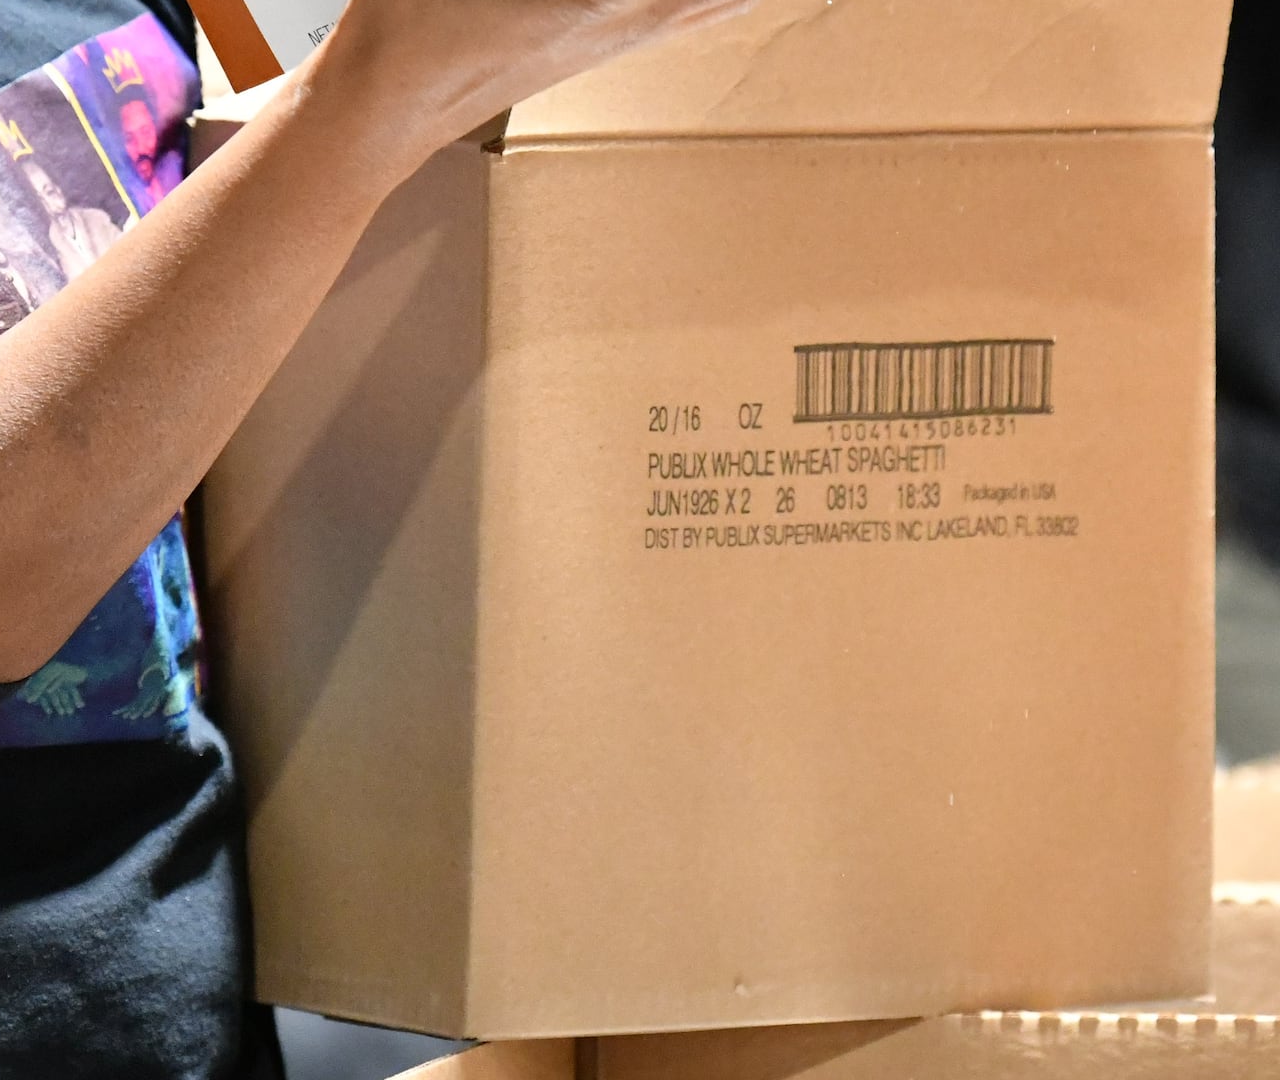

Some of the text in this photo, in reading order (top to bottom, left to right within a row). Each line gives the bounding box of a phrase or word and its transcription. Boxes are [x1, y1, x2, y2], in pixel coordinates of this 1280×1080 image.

[738, 403, 763, 429] OZ
[648, 444, 946, 479] PUBLIX WHOLE WHEAT SPAGHETTI
[646, 488, 719, 516] JUN1926
[741, 487, 751, 514] 2
[776, 487, 795, 514] 26
[827, 483, 868, 510] 0813
[898, 482, 941, 510] 18:33
[964, 483, 1057, 505] Packaged in USA
[645, 527, 679, 549] DIST
[683, 527, 702, 548] BY
[706, 524, 760, 547] PUBLIX
[764, 520, 891, 546] SUPERMARKETS
[896, 521, 923, 542] INC
[1016, 515, 1033, 536] FL
